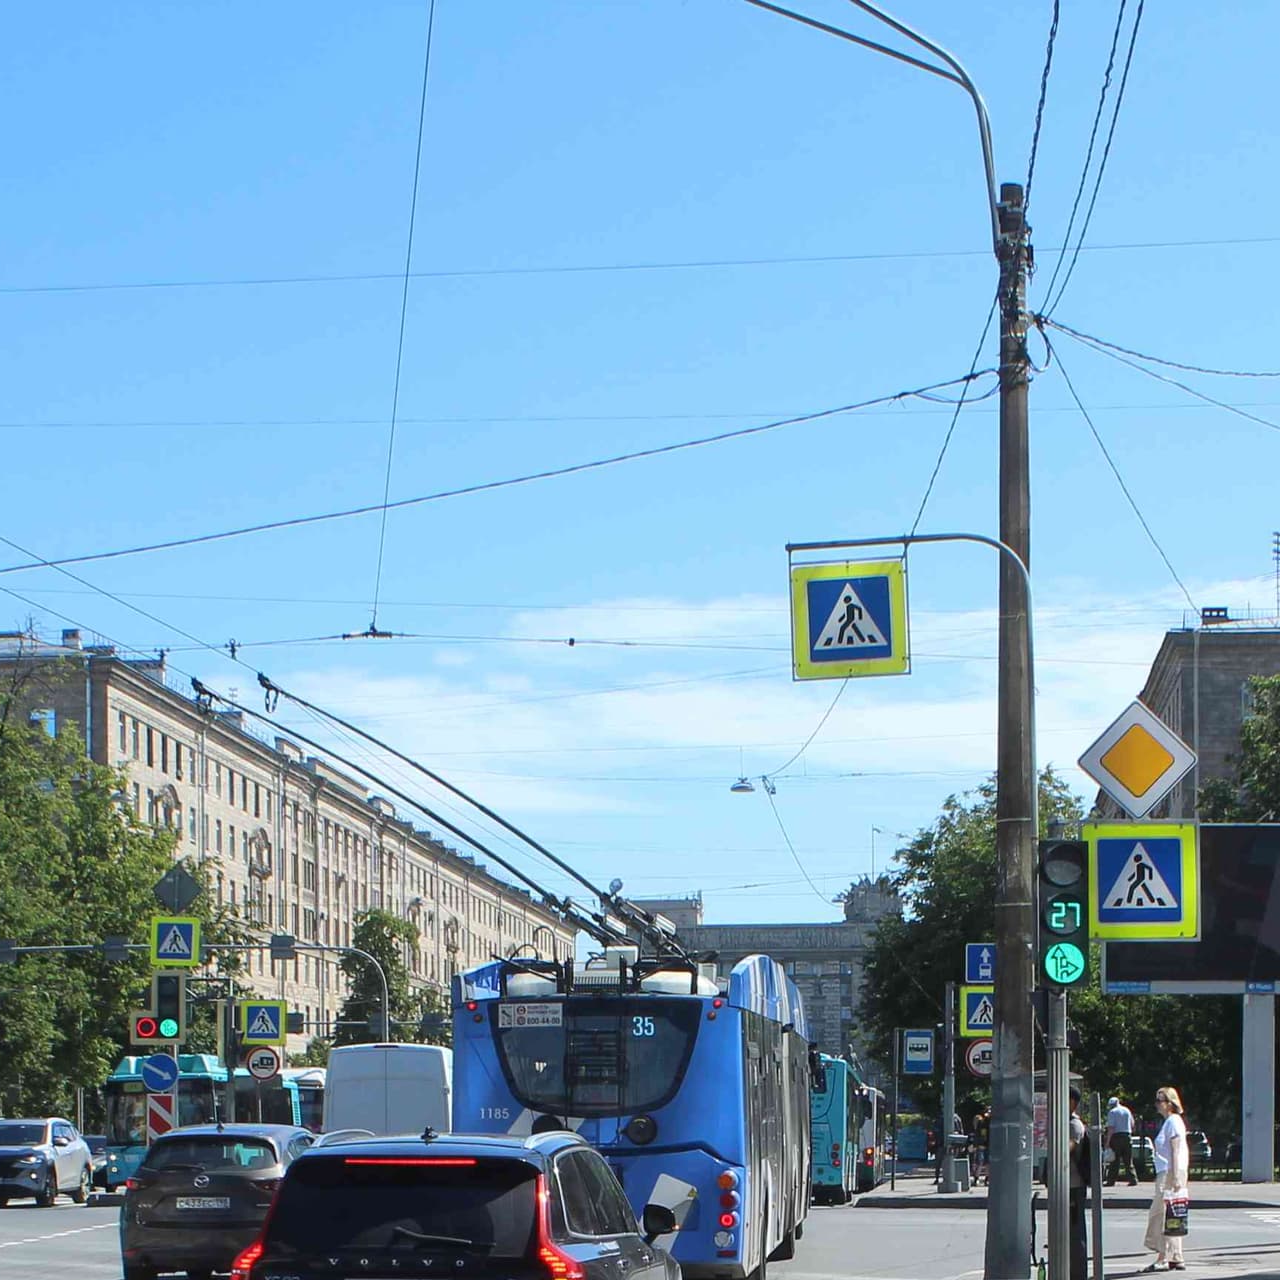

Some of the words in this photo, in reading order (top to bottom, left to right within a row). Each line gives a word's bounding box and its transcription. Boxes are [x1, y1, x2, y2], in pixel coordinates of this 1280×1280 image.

[1052, 902, 1081, 928] 27
[632, 1016, 655, 1036] 35
[479, 1108, 510, 1120] 1185
[329, 1258, 464, 1267] VOLVO
